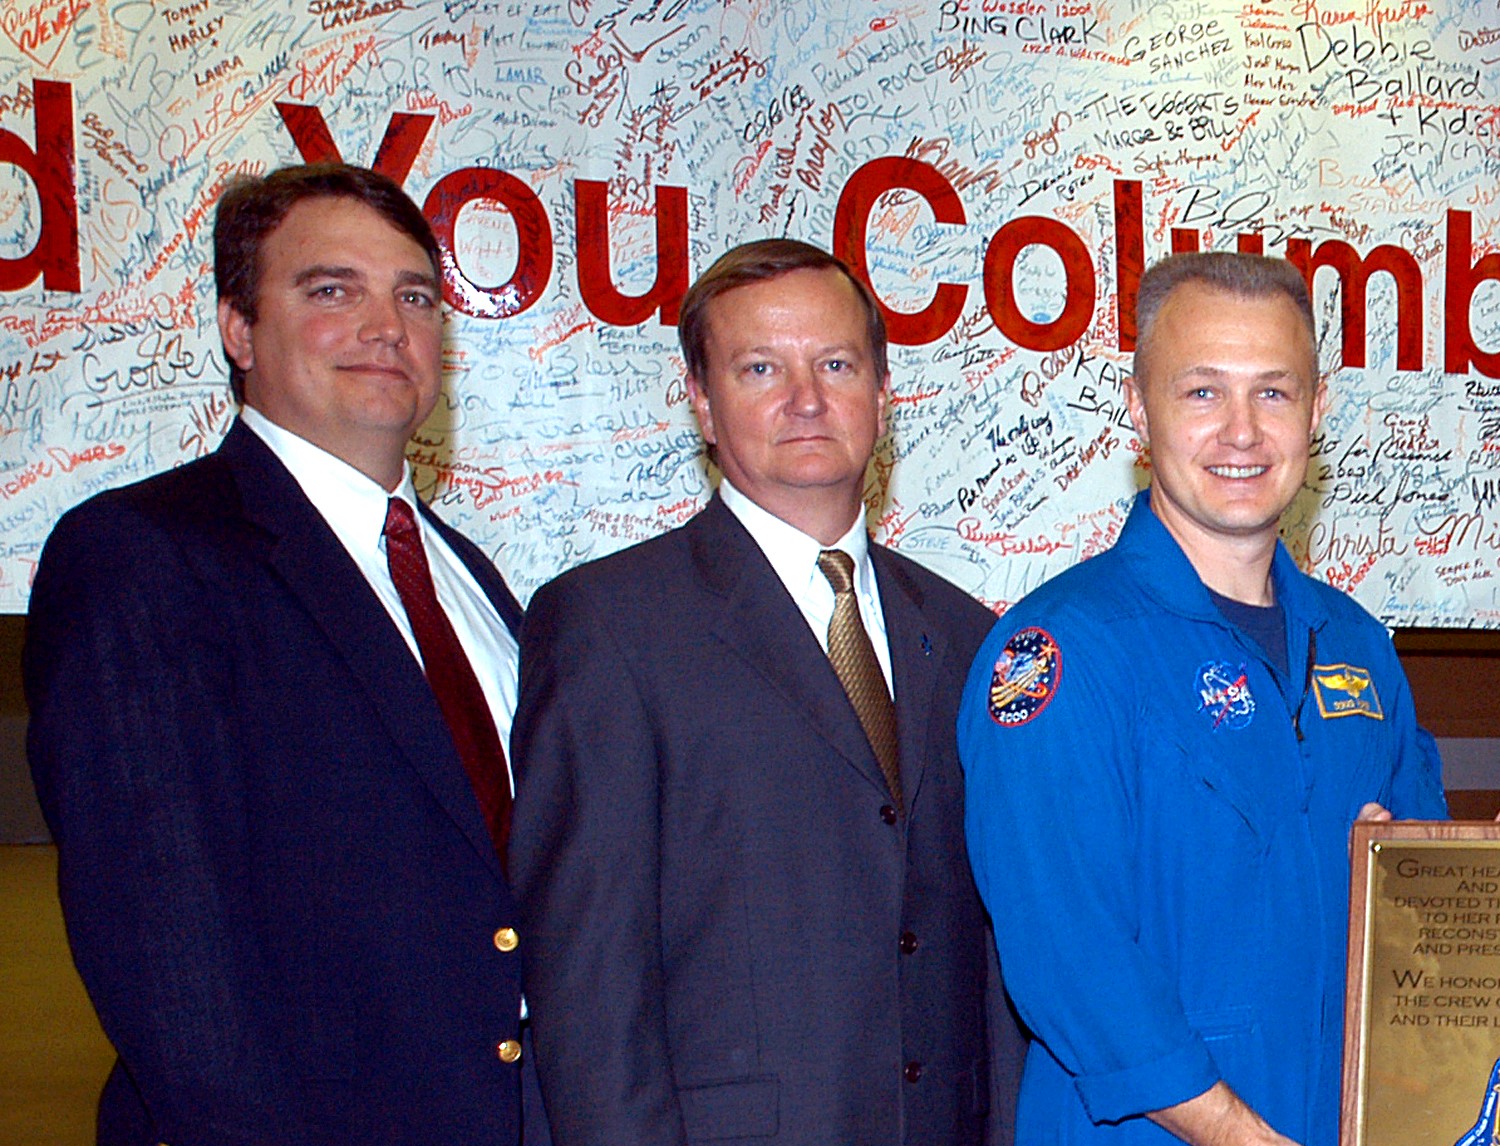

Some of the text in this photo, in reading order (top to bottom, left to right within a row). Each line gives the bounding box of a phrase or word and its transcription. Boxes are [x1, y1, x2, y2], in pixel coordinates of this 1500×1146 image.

[169, 16, 225, 53] HARLEY
[1149, 37, 1234, 75] SANCHEZ
[1296, 21, 1436, 73] Debbie
[194, 55, 243, 87] LAURA
[1345, 66, 1486, 104] Ballard
[1397, 859, 1468, 879] GREAT
[1457, 880, 1498, 894] AND
[1394, 897, 1481, 910] DEVOTED
[1425, 912, 1448, 924] TO
[1453, 912, 1490, 925] HER
[1413, 943, 1455, 956] AND
[1392, 969, 1435, 989] WE
[1393, 994, 1430, 1008] THE
[1434, 995, 1491, 1009] CREW
[1390, 1014, 1430, 1027] AND
[1435, 1015, 1488, 1028] THEIR
